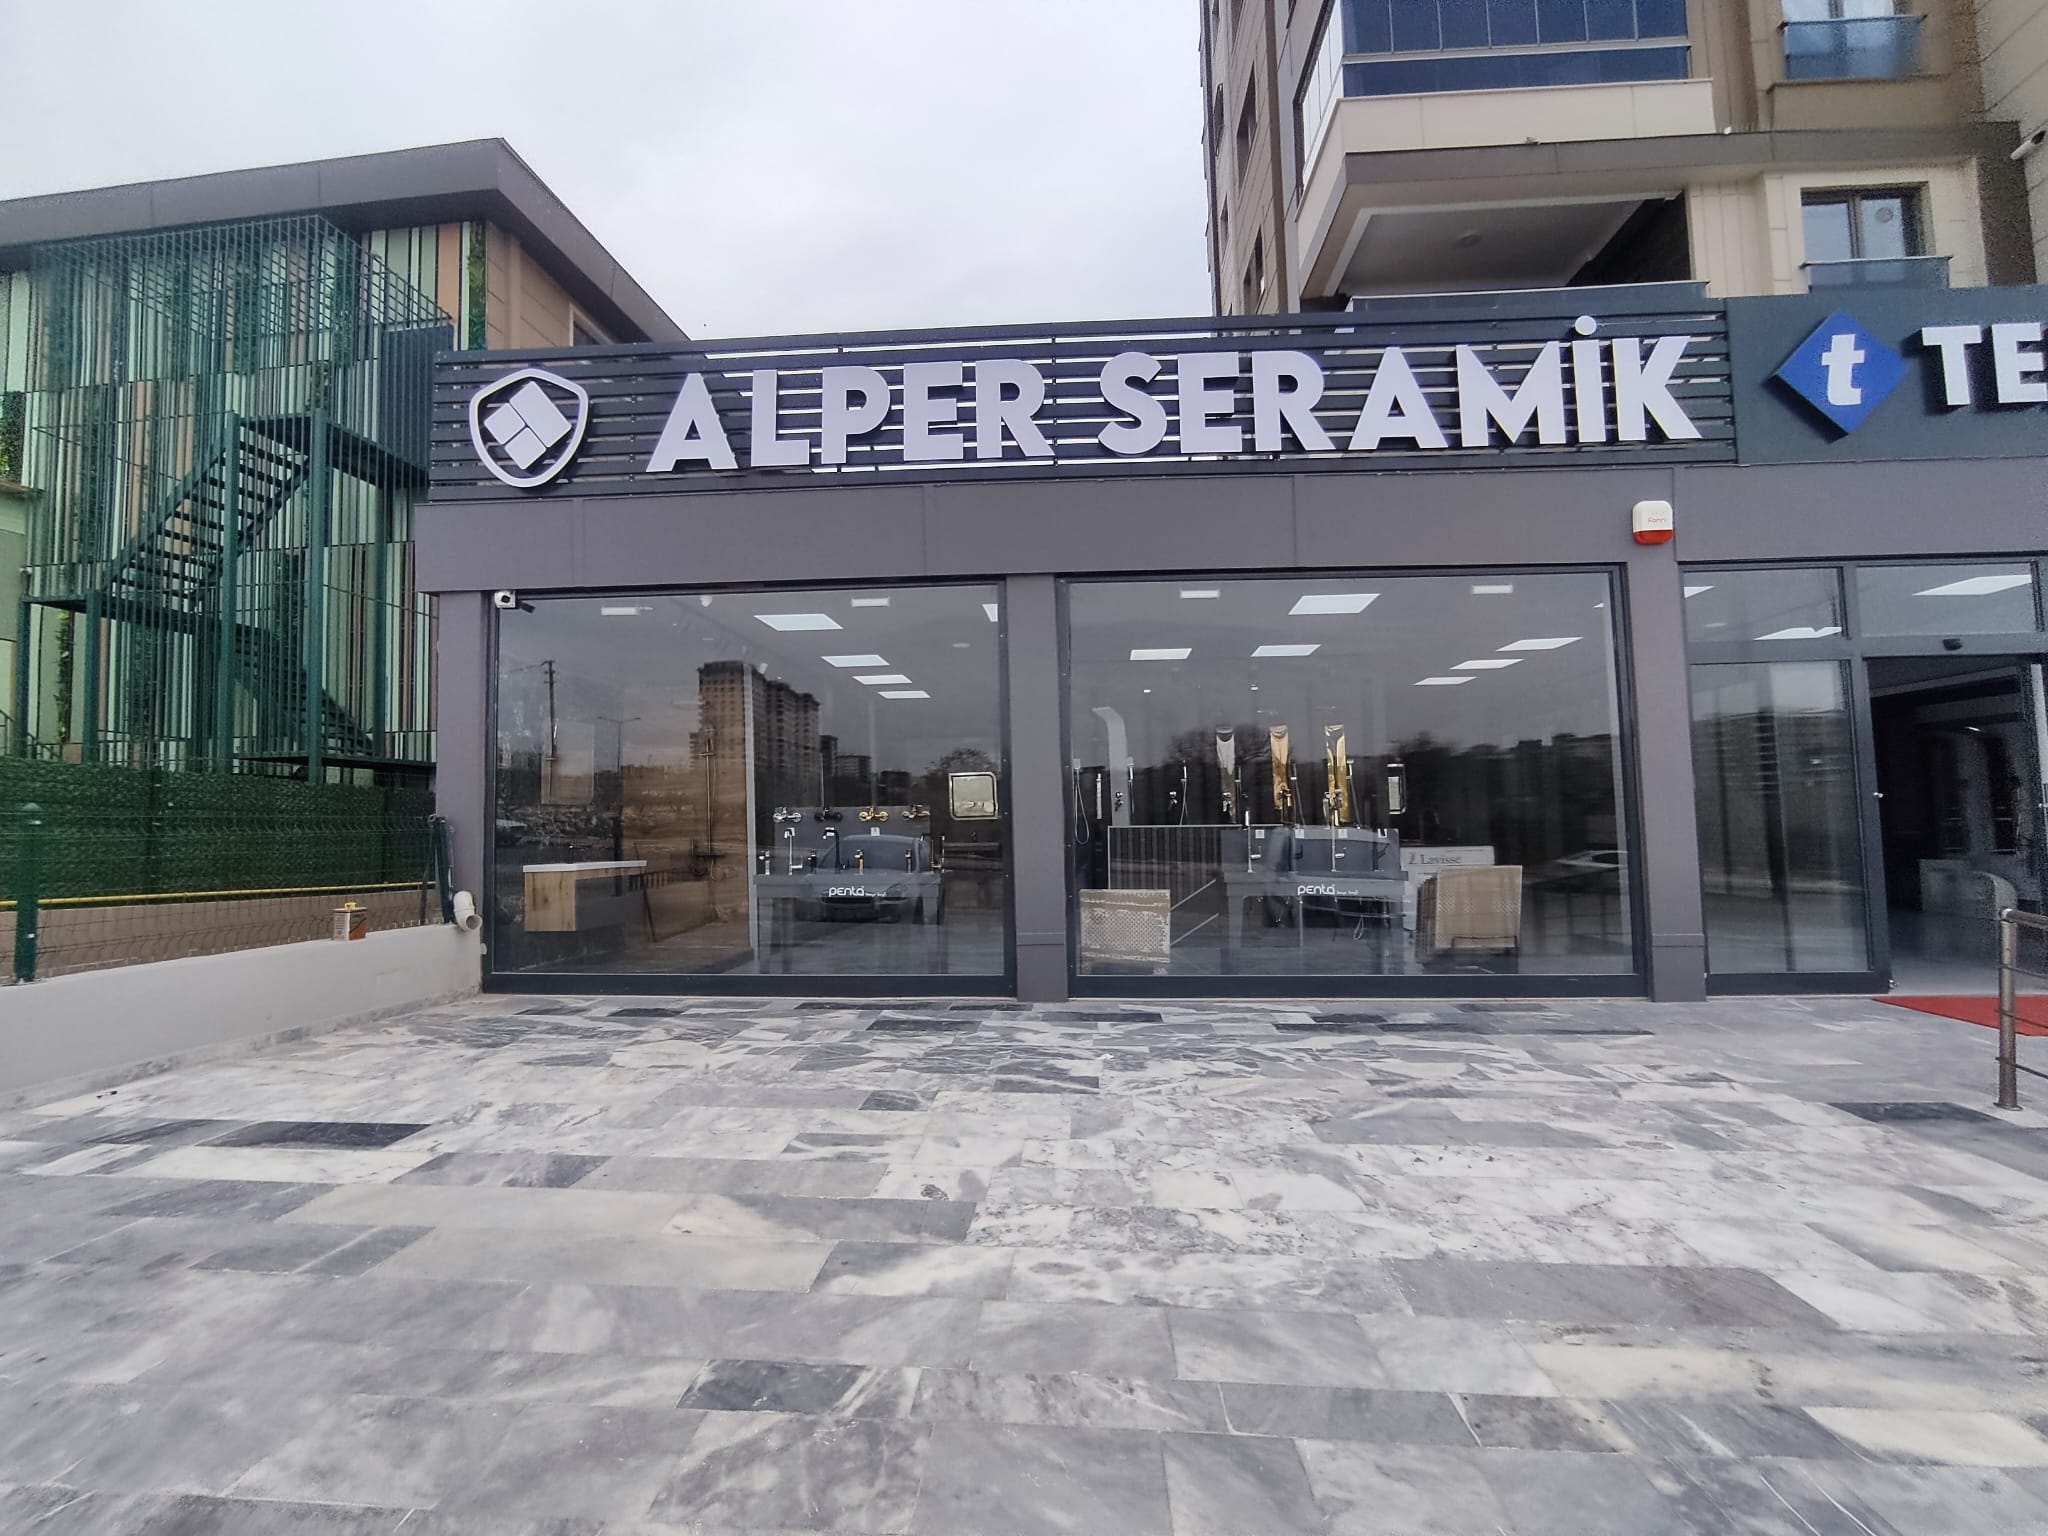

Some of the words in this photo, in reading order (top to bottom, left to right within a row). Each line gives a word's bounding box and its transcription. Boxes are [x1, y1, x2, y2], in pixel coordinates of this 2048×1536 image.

[1821, 333, 1866, 406] t
[1921, 322, 2048, 406] TE
[646, 358, 1056, 473] ALPER
[1097, 315, 1703, 455] SERAMİK
[828, 885, 865, 898] penta
[1297, 883, 1336, 896] penta
